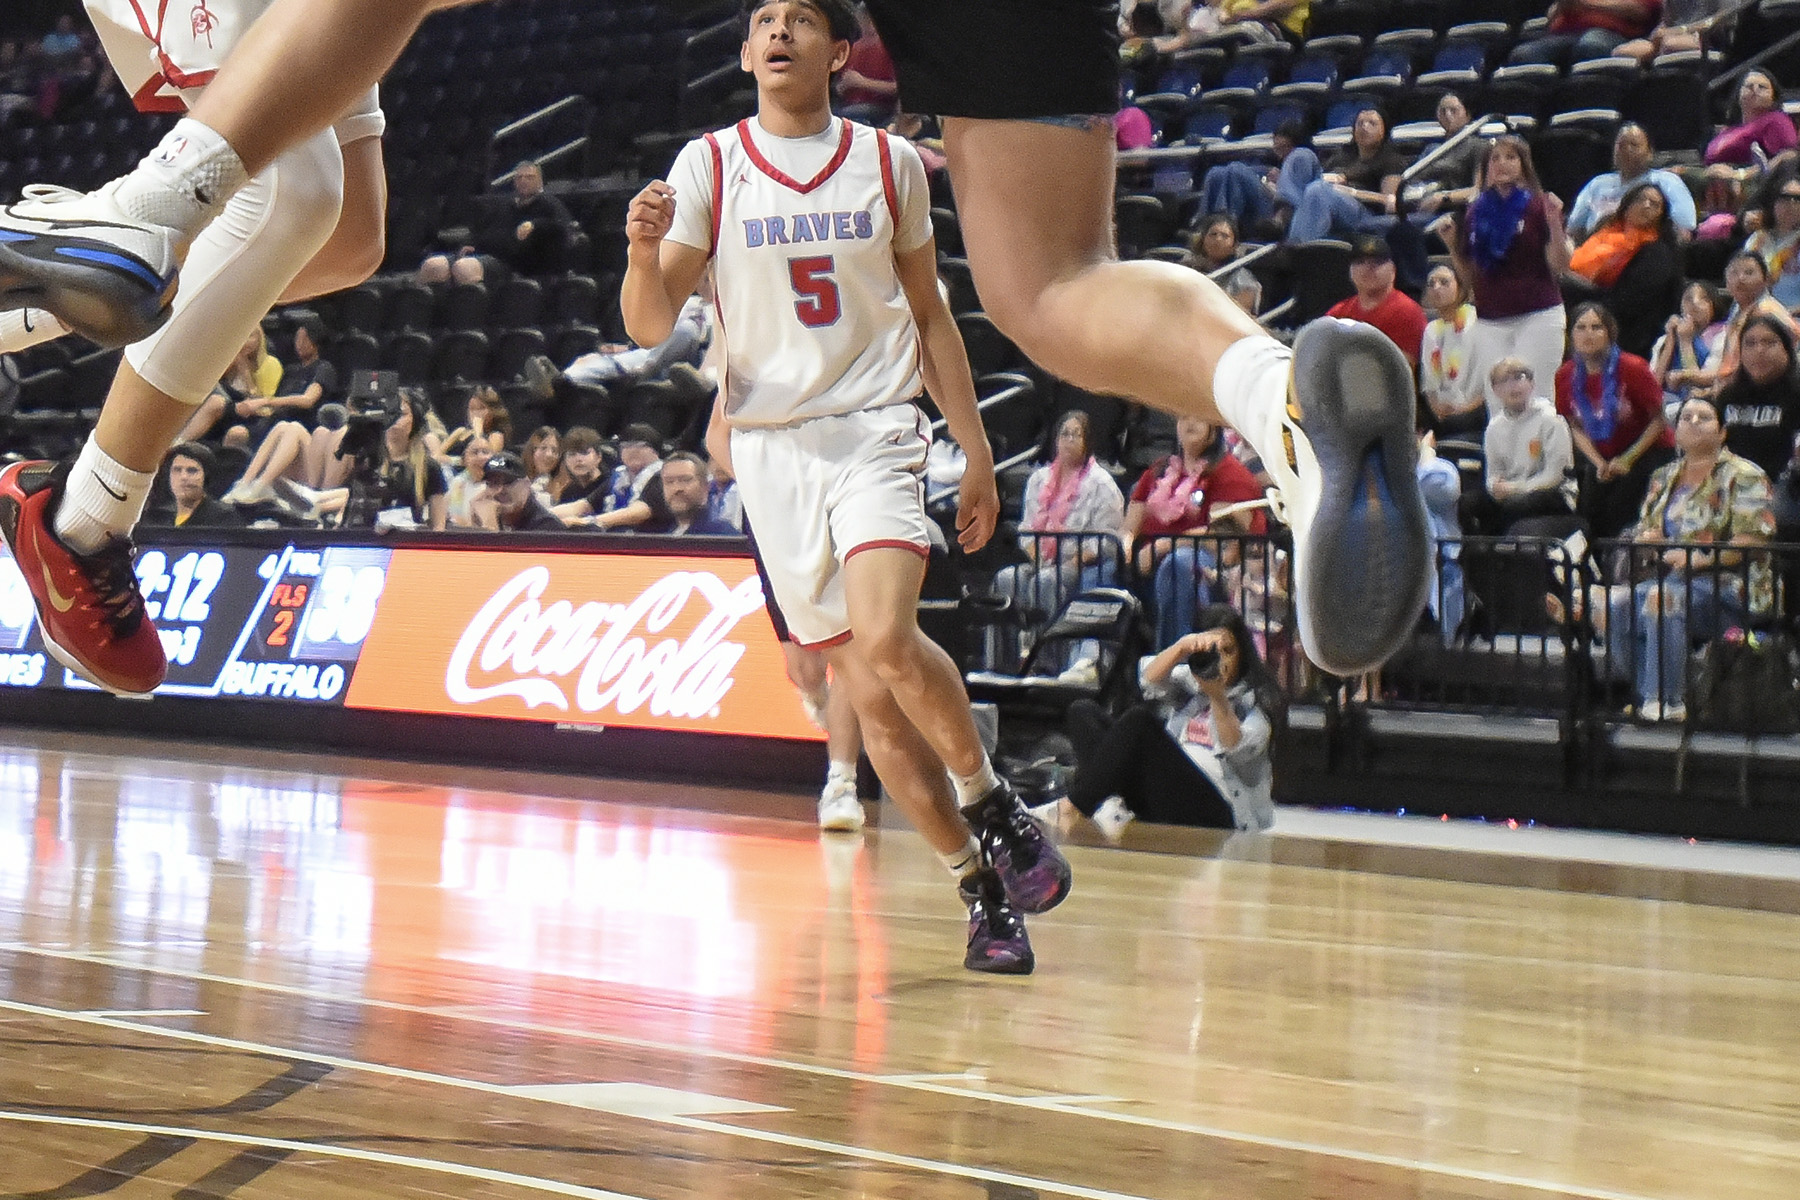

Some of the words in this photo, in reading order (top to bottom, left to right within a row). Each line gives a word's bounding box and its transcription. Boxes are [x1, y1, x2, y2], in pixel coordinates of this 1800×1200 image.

[743, 210, 874, 249] BRAVES
[787, 254, 843, 329] 5
[269, 583, 308, 608] FLS
[266, 610, 295, 646] 2
[445, 565, 767, 719] Coca-Cola
[222, 660, 345, 701] BUFFALO
